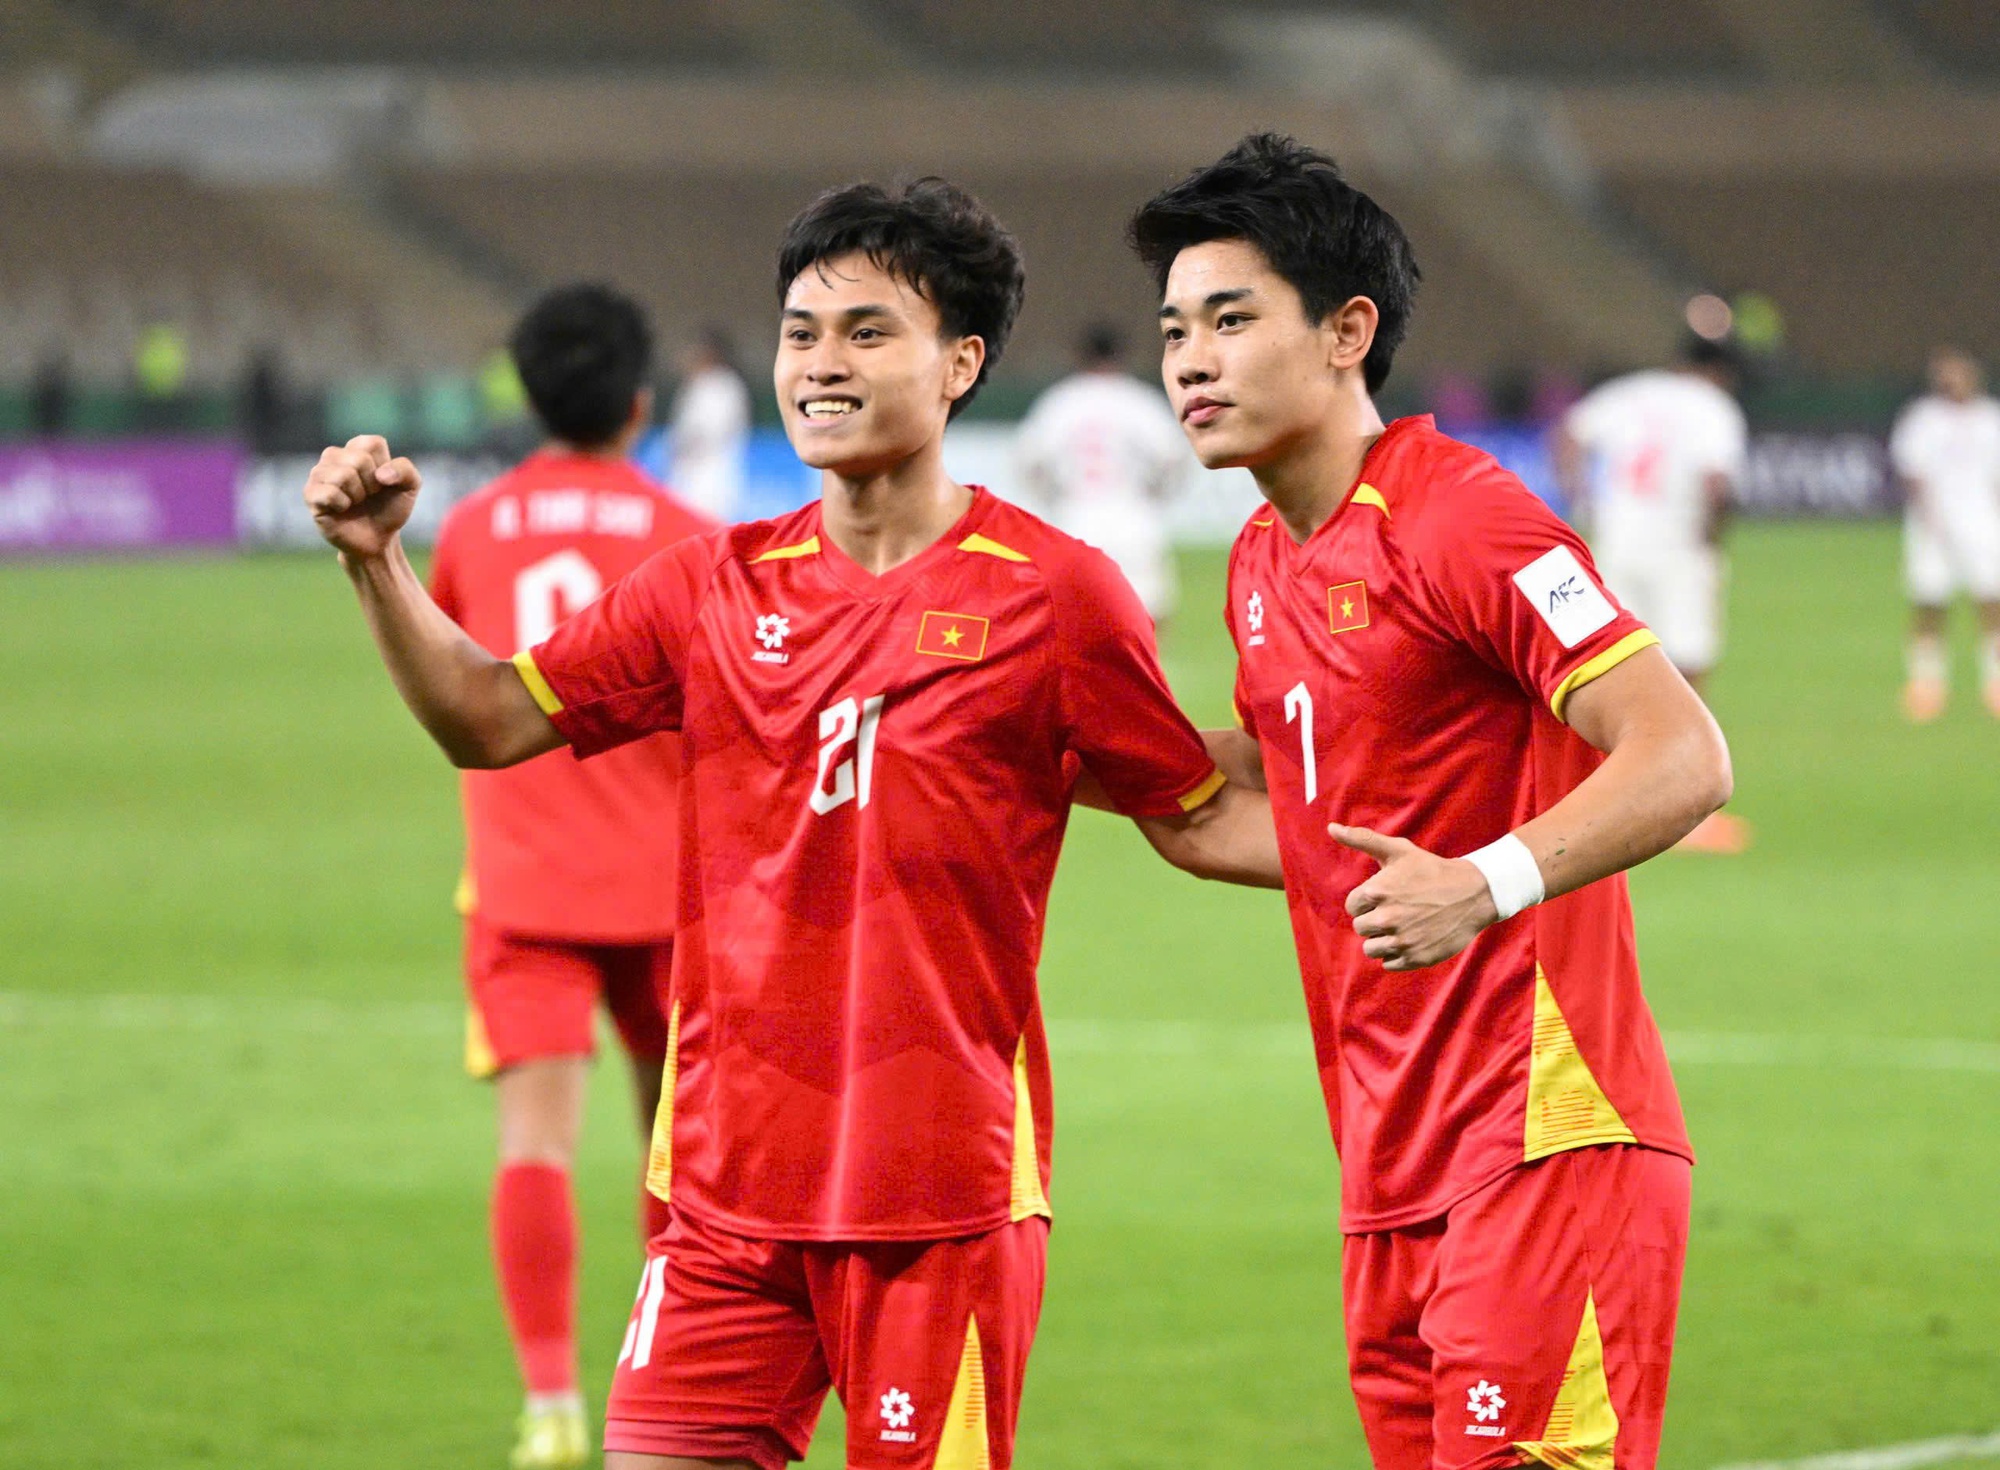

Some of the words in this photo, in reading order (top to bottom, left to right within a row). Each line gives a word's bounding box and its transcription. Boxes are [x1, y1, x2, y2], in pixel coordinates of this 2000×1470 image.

[1549, 575, 1585, 614] AFC
[809, 694, 886, 816] 21
[1284, 681, 1317, 805] 7
